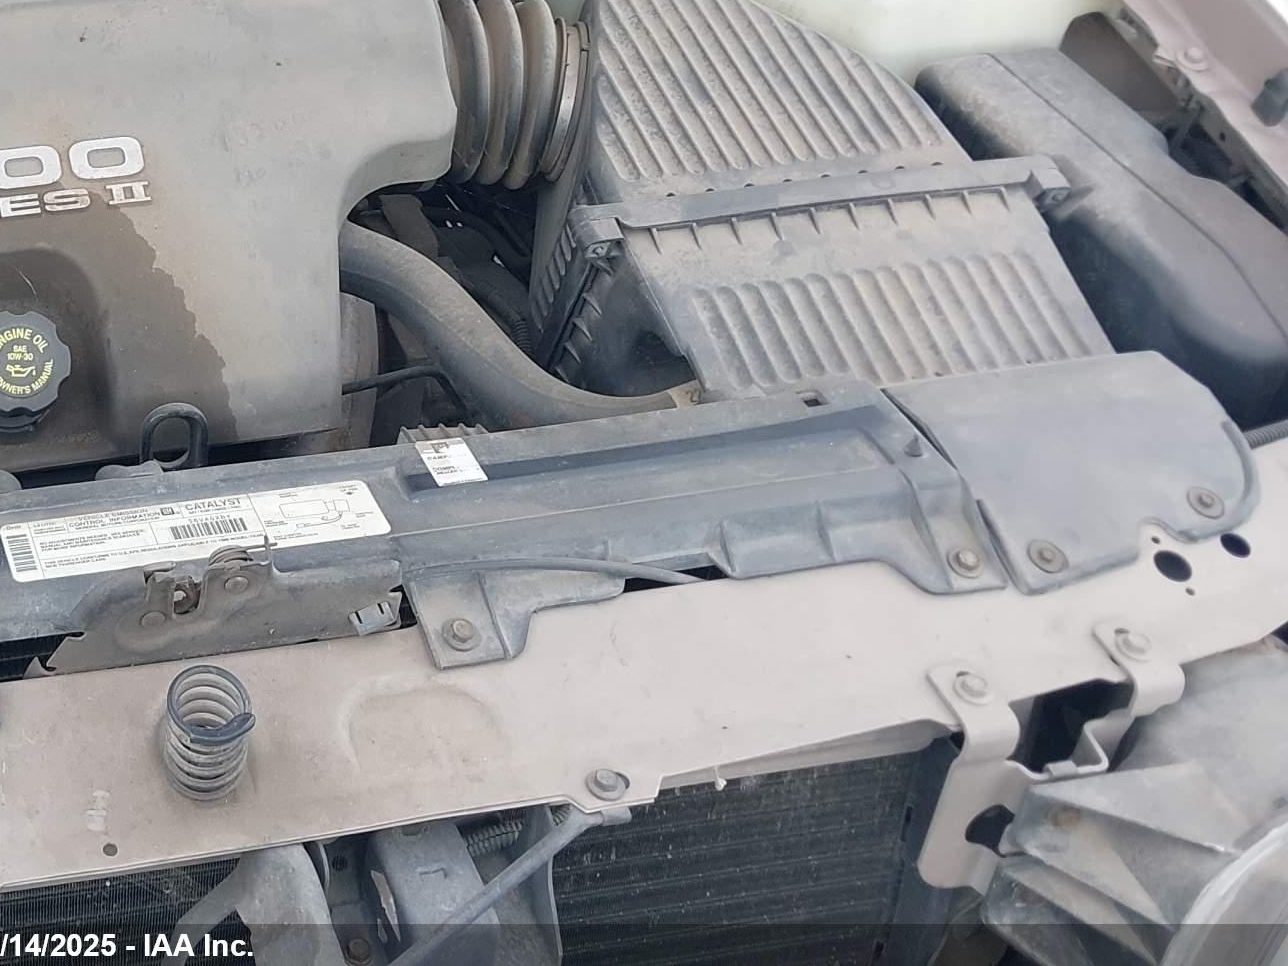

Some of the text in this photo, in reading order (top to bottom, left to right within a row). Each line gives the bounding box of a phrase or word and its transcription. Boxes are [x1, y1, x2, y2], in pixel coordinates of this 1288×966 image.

[105, 181, 152, 205] II
[13, 345, 27, 353] SAE
[33, 334, 49, 354] OIL
[7, 353, 33, 361] 10W-30
[31, 358, 54, 391] MANUAL
[183, 497, 243, 511] CATALYST
[67, 511, 161, 528] CONTROL INFORMATION
